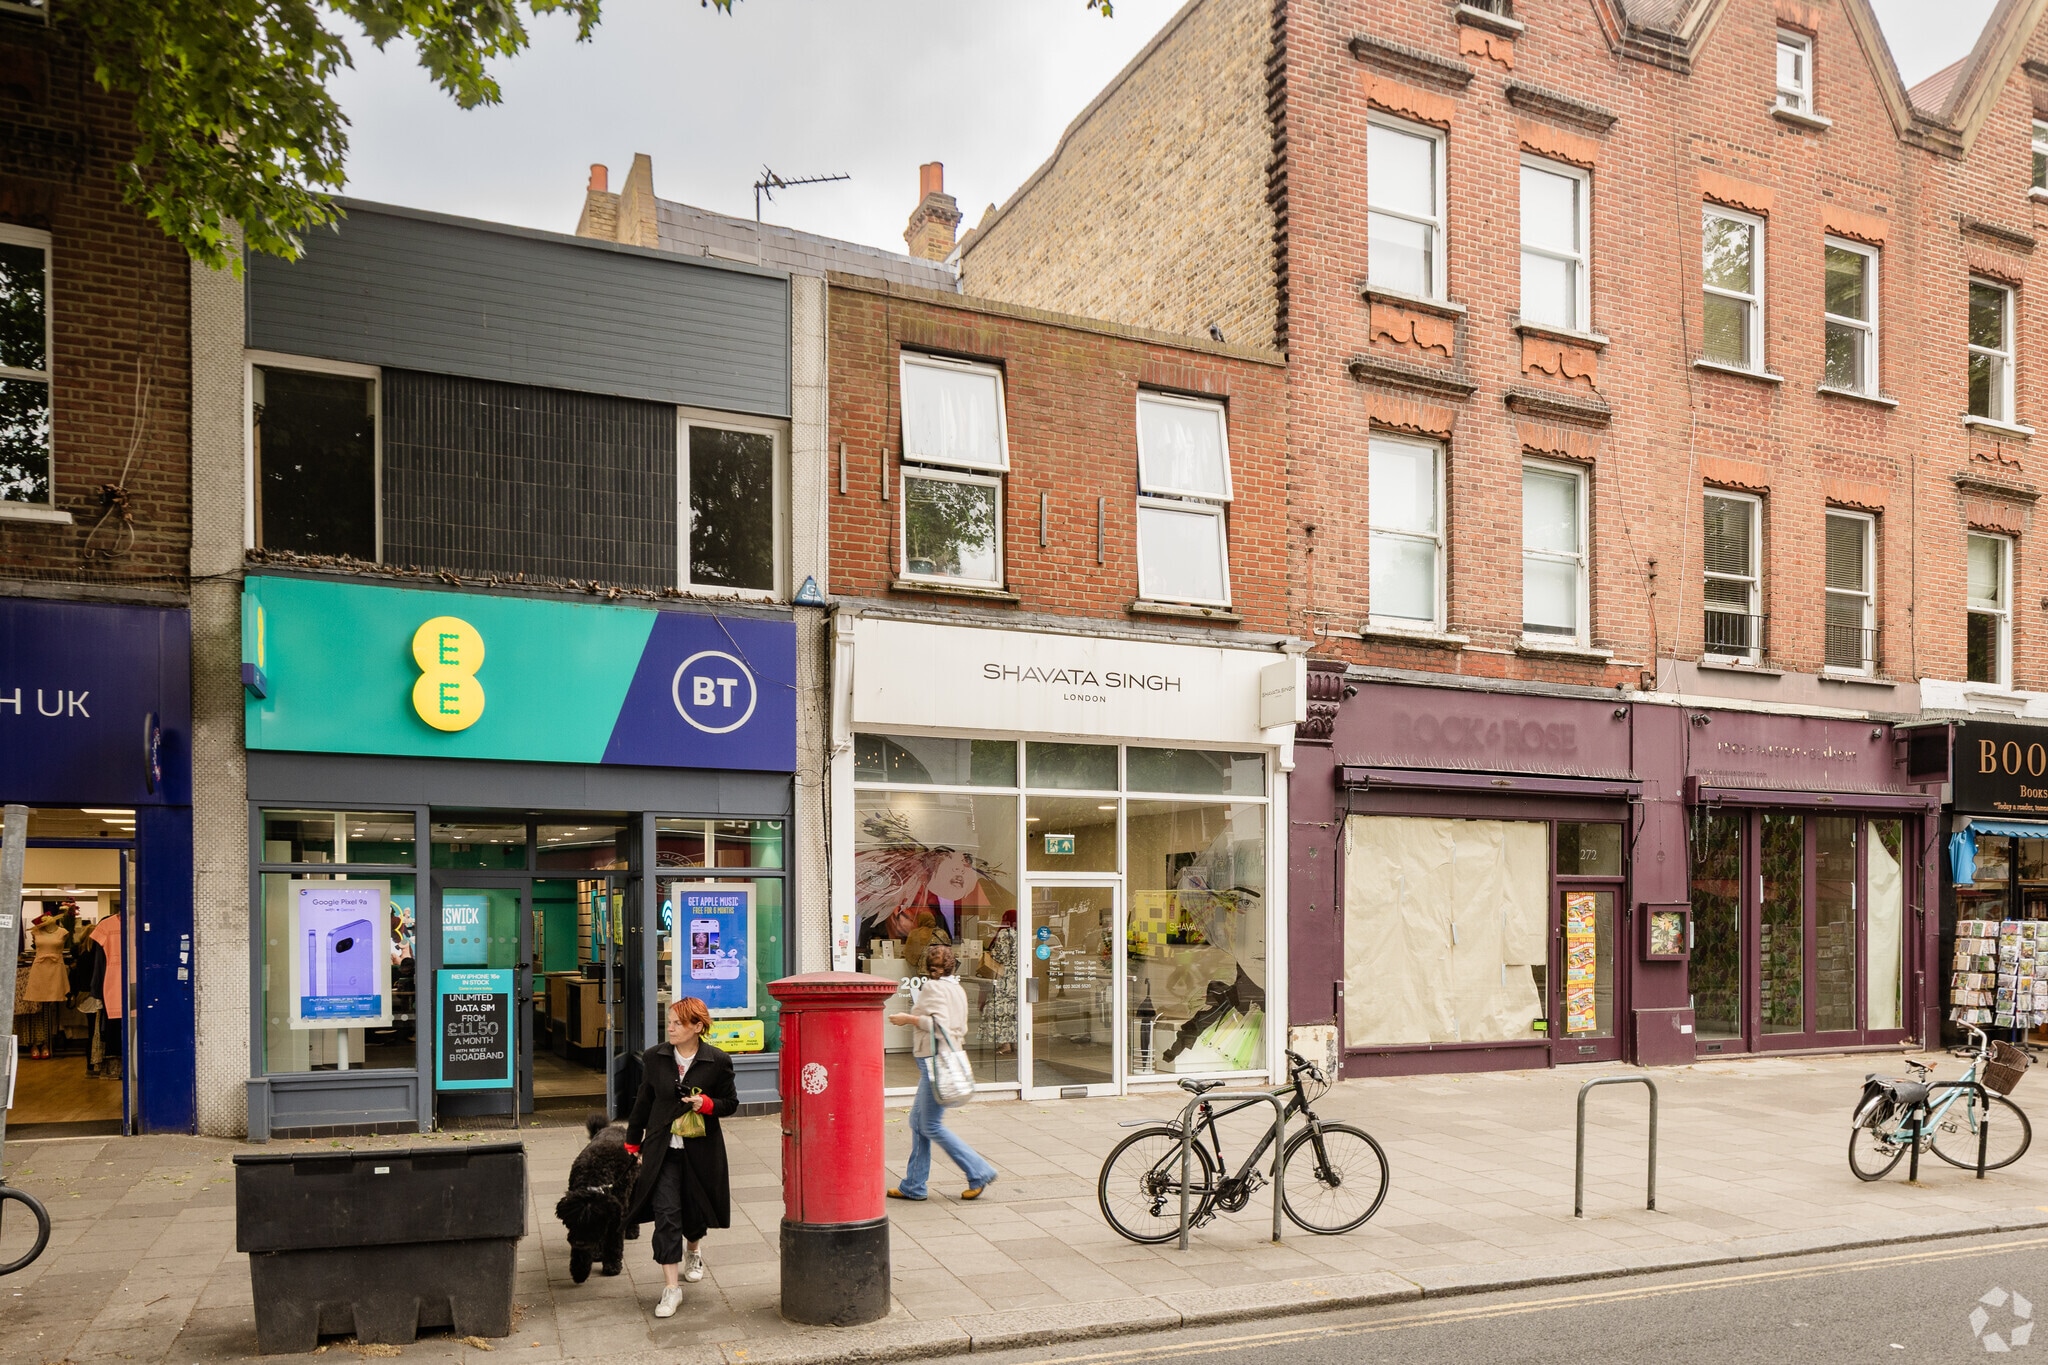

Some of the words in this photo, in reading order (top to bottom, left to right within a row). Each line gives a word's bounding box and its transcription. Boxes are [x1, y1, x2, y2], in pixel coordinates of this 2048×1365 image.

[984, 664, 1100, 687] SHAVATA
[1105, 672, 1181, 692] SINGH
[693, 676, 738, 708] BT
[38, 688, 90, 718] UK
[1064, 694, 1106, 703] LONDON
[1580, 849, 1597, 860] 272
[688, 896, 700, 906] GET
[700, 896, 718, 906] APPLE
[720, 896, 738, 906] MUSIC
[447, 1022, 499, 1036] £11.50
[449, 1052, 504, 1062] BROADBAND
